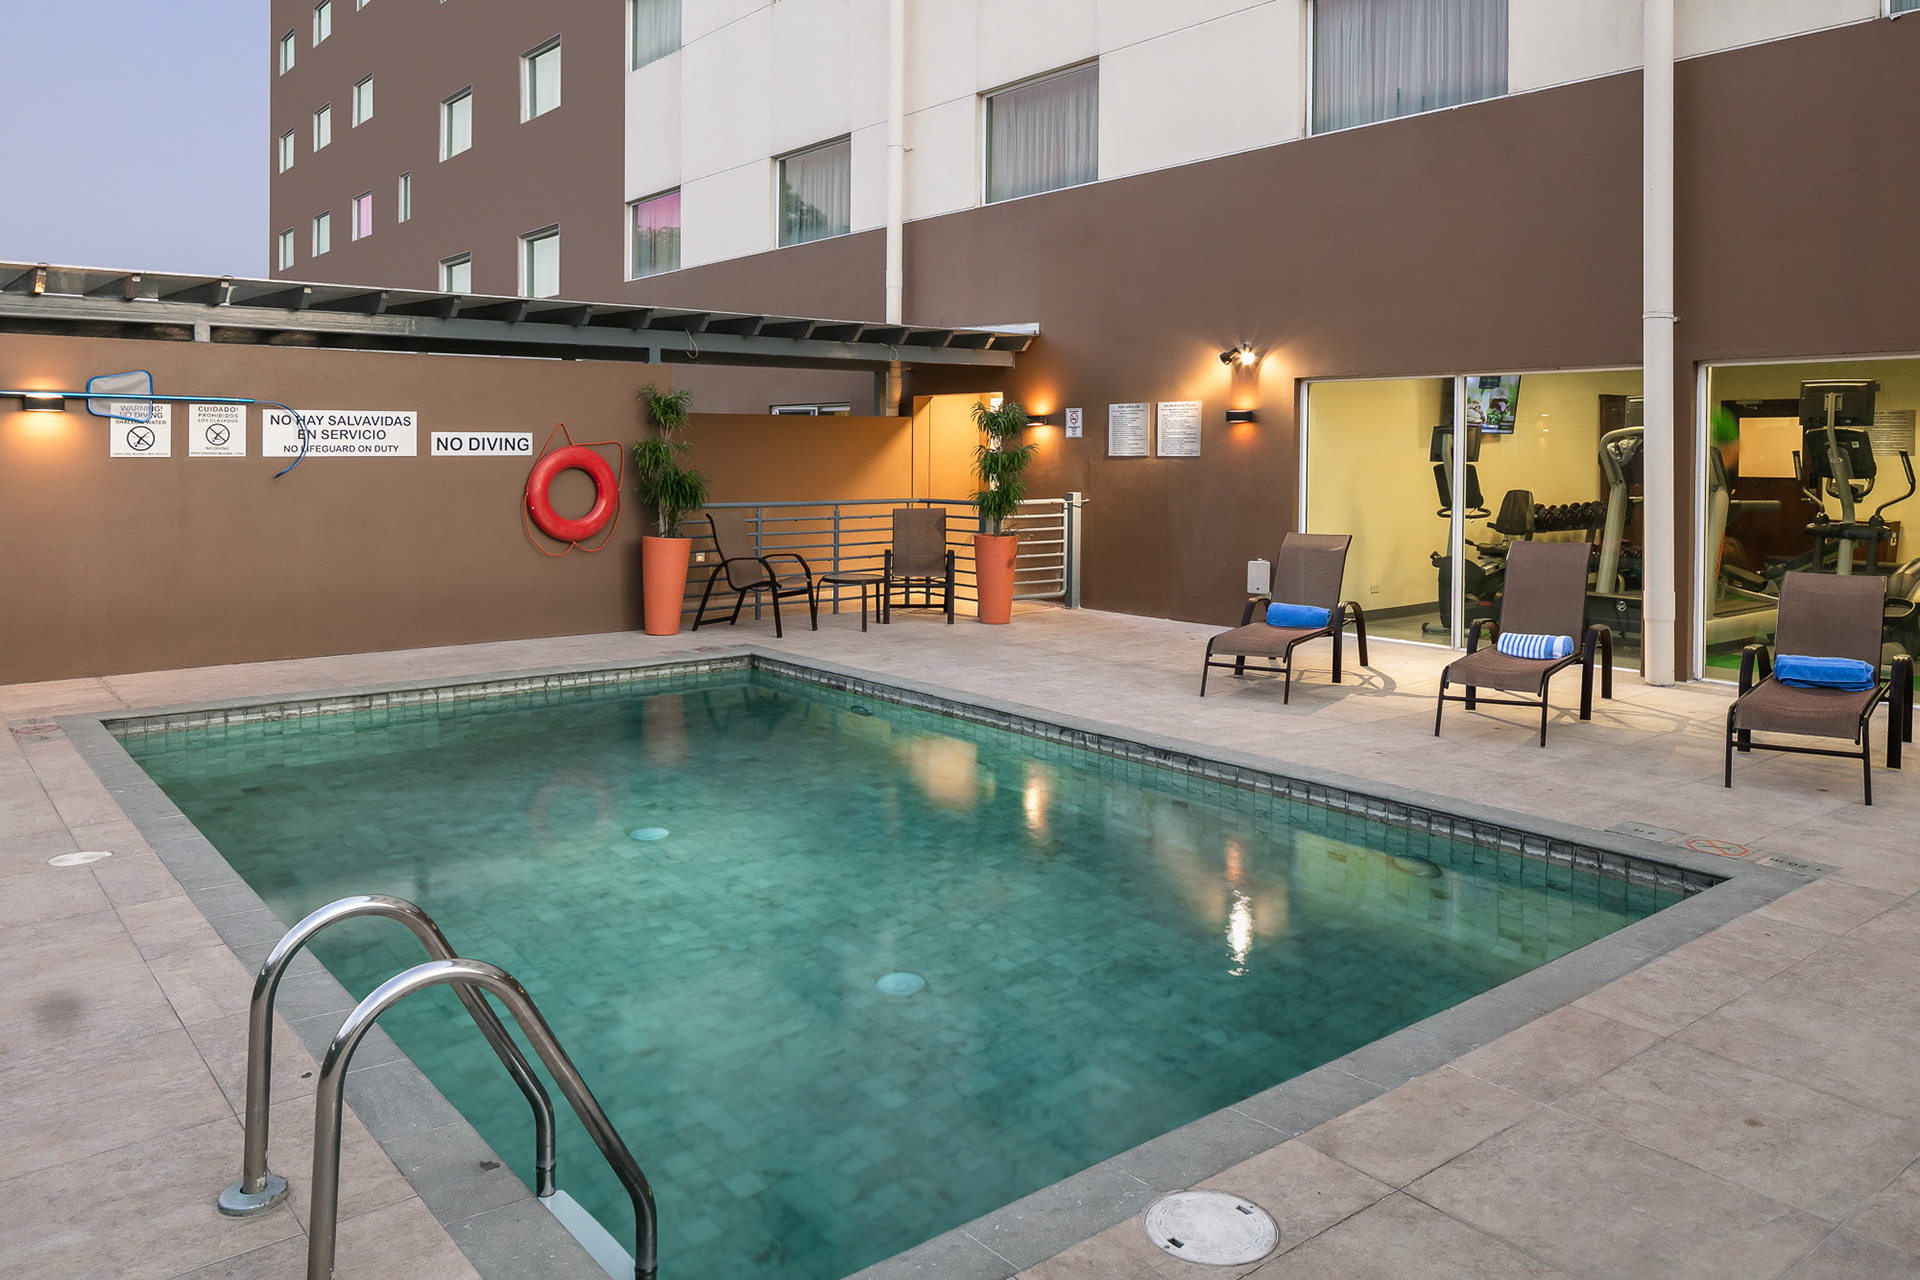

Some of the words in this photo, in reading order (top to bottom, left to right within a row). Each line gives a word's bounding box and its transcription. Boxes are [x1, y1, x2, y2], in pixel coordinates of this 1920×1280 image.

[270, 414, 292, 426] NO
[296, 414, 324, 426] HAY
[328, 415, 411, 427] SALVAVIDAS
[297, 429, 317, 440] EN
[320, 429, 387, 440] SERVICIO
[283, 444, 298, 453] NO
[357, 444, 372, 453] ON
[374, 444, 399, 453] DUTY
[436, 437, 463, 451] NO
[468, 437, 530, 452] DIVING
